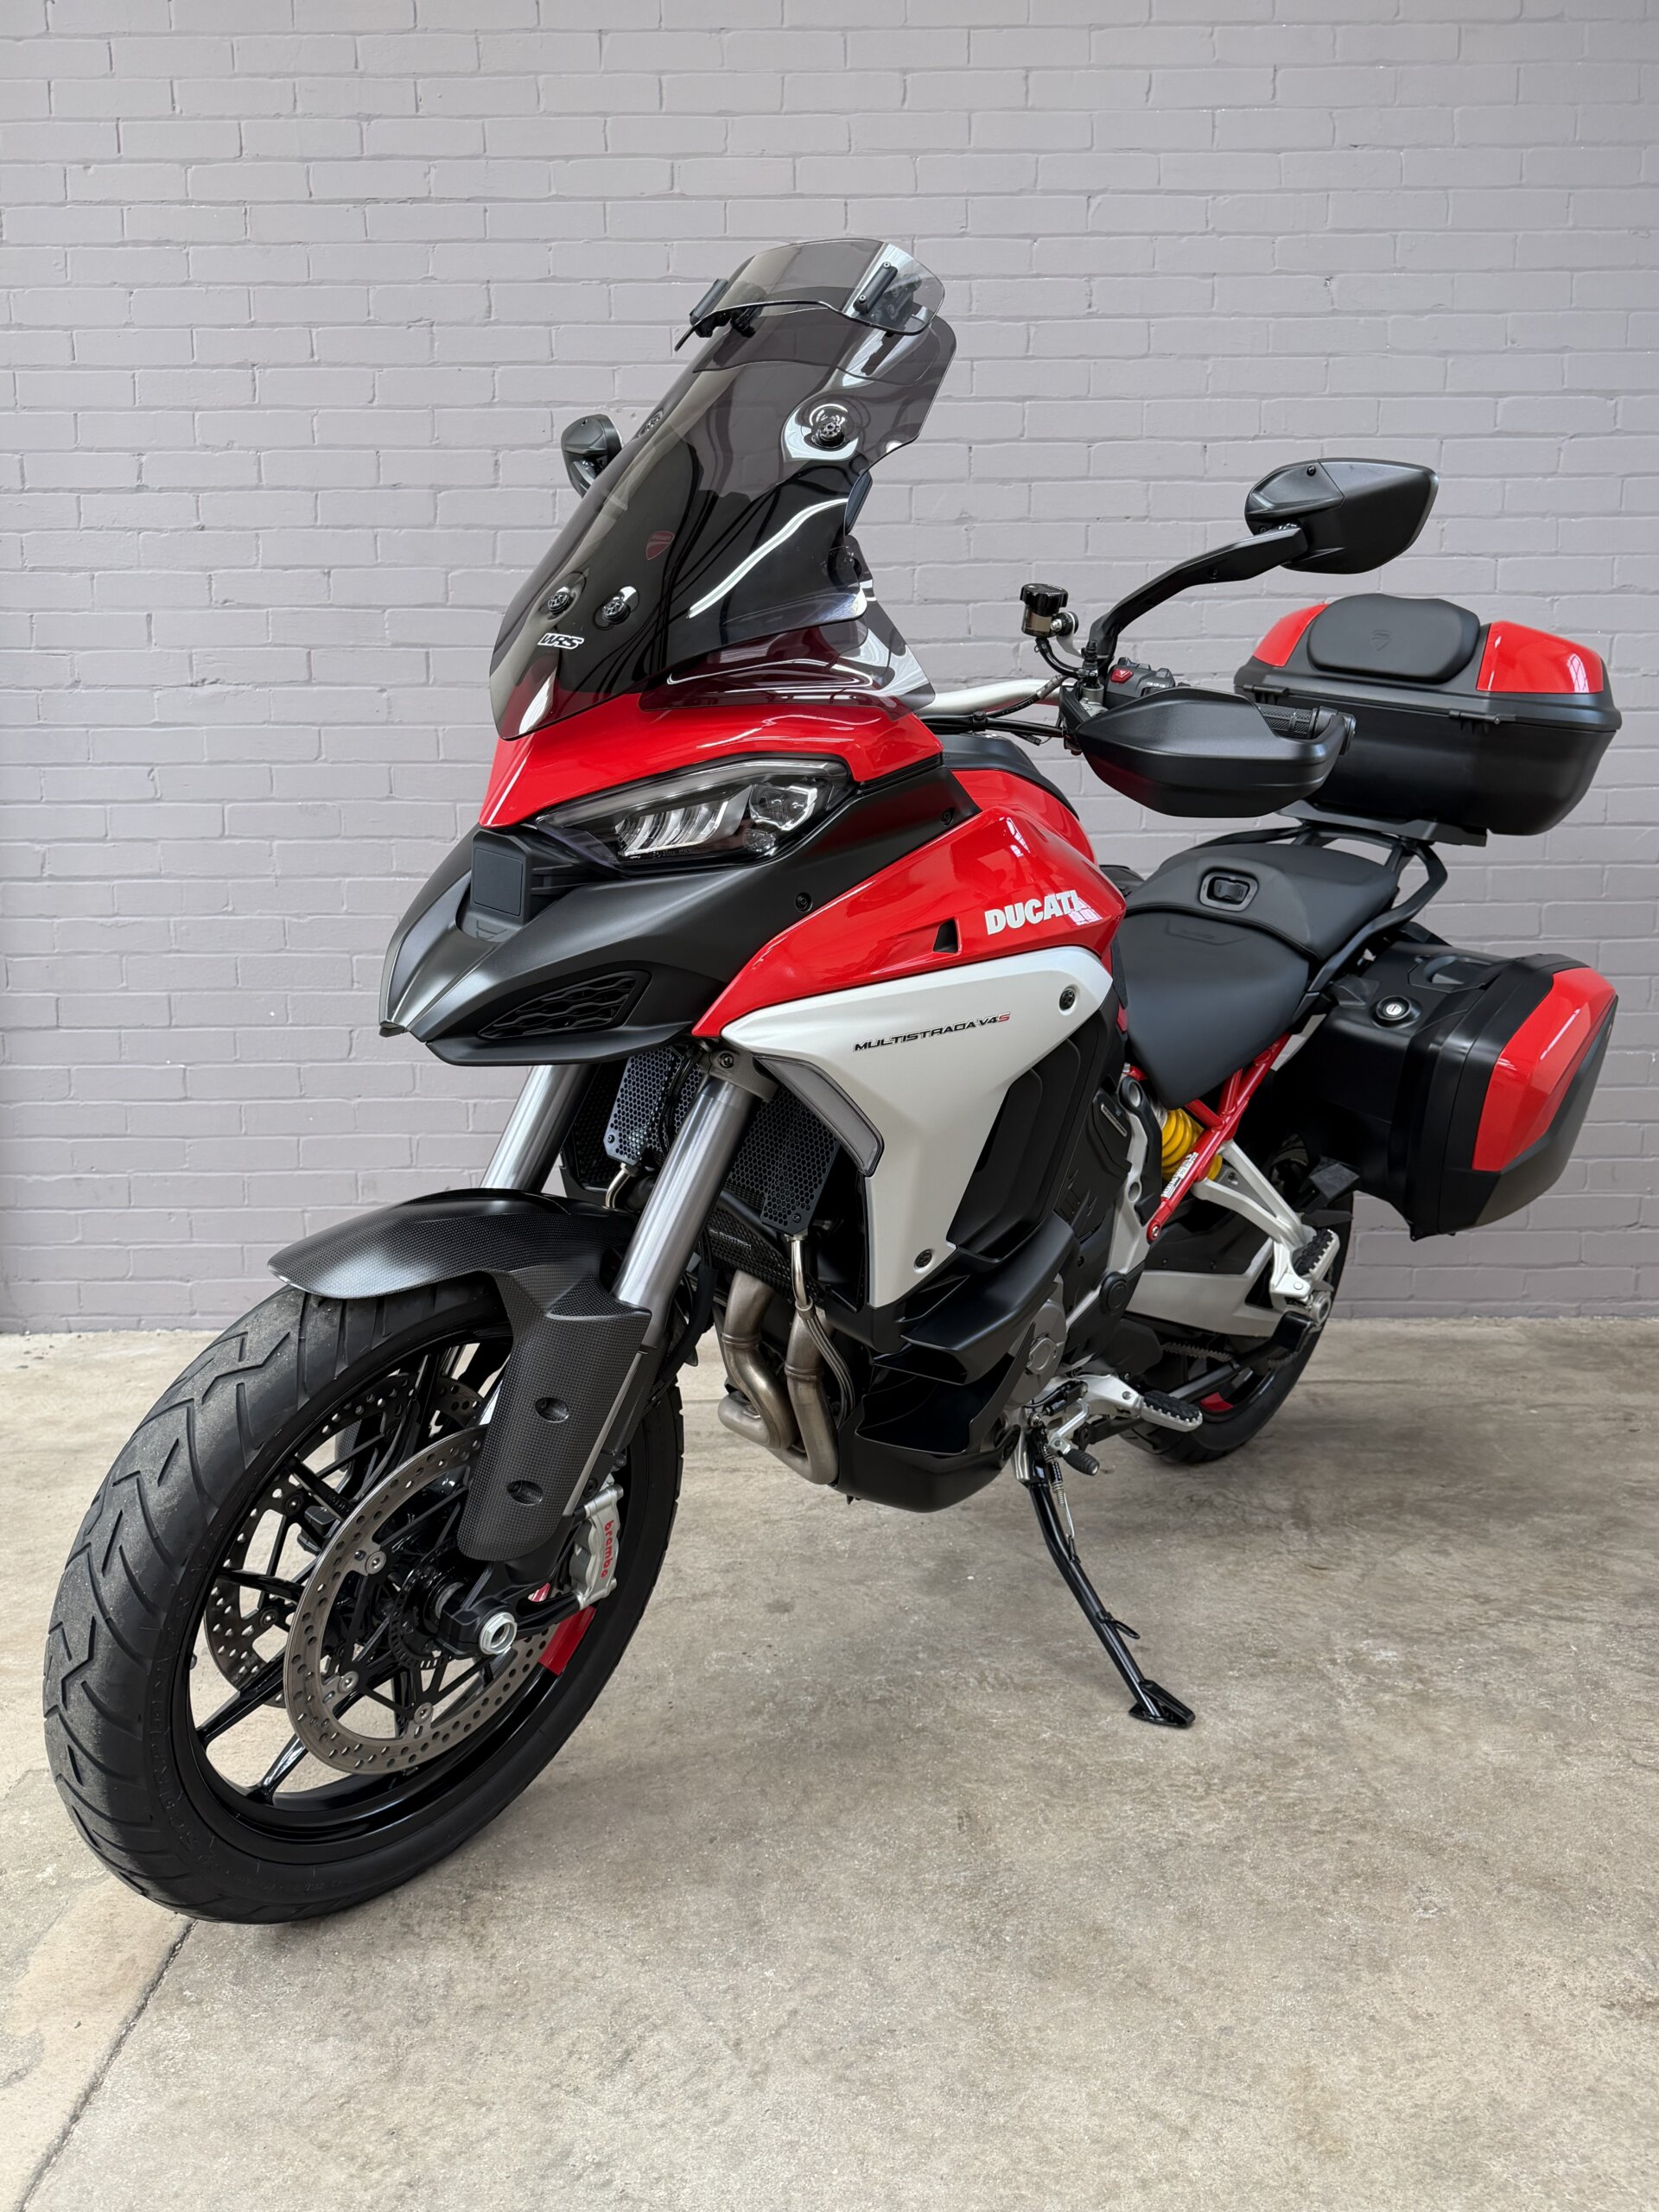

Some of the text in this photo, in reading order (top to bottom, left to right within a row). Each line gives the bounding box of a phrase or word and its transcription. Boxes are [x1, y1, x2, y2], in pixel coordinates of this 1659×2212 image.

[537, 633, 584, 649] WRS
[984, 889, 1081, 935] DUCATI
[854, 1012, 1010, 1052] MULTISTRADA V4S
[601, 1520, 614, 1578] brembo
